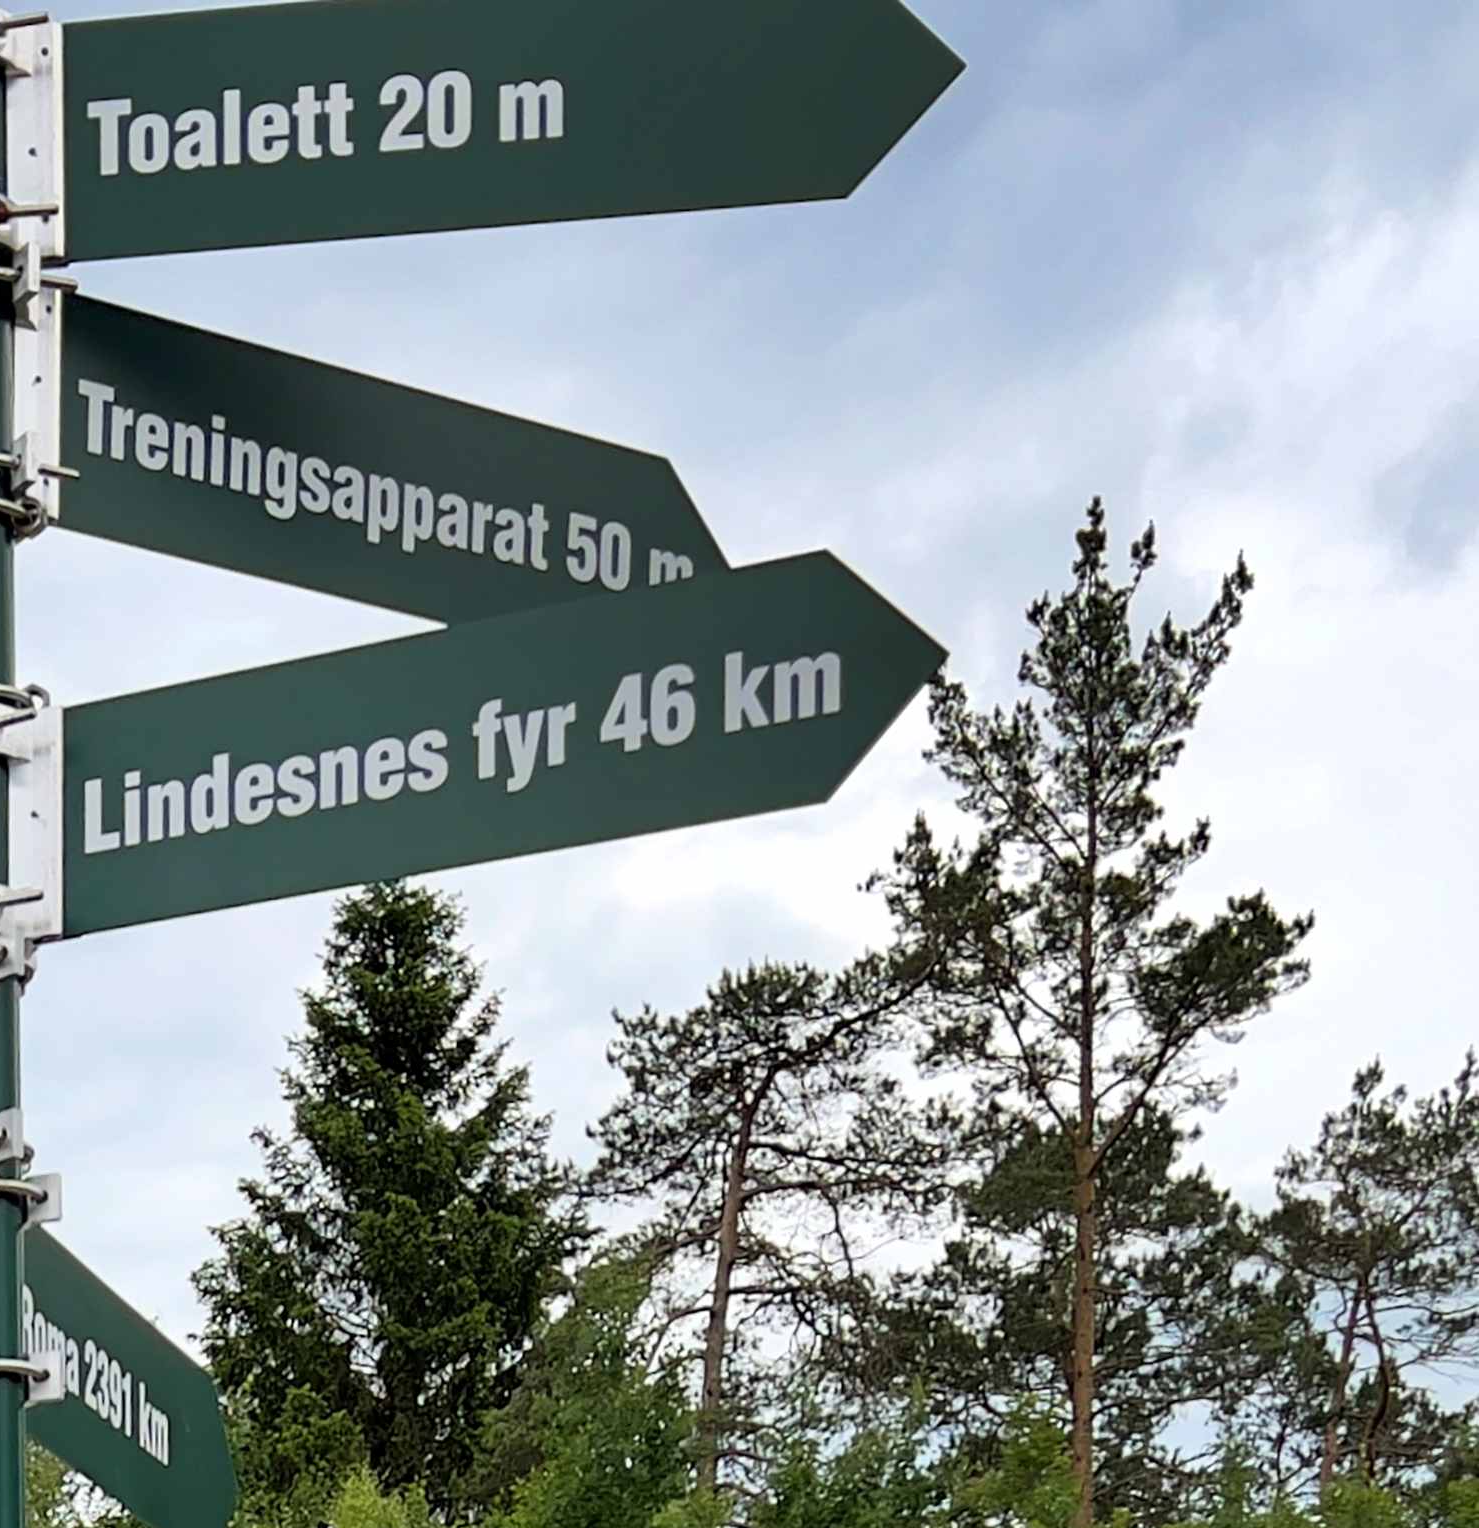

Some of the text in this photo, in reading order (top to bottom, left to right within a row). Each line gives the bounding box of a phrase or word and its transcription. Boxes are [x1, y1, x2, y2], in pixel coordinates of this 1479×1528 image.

[87, 70, 564, 176] Toalett 20 m
[78, 378, 694, 591] Treningsapparat 50 m
[84, 640, 841, 854] Lindesnes fyr 46 km
[84, 1339, 132, 1438] 2391
[138, 1381, 169, 1466] km
